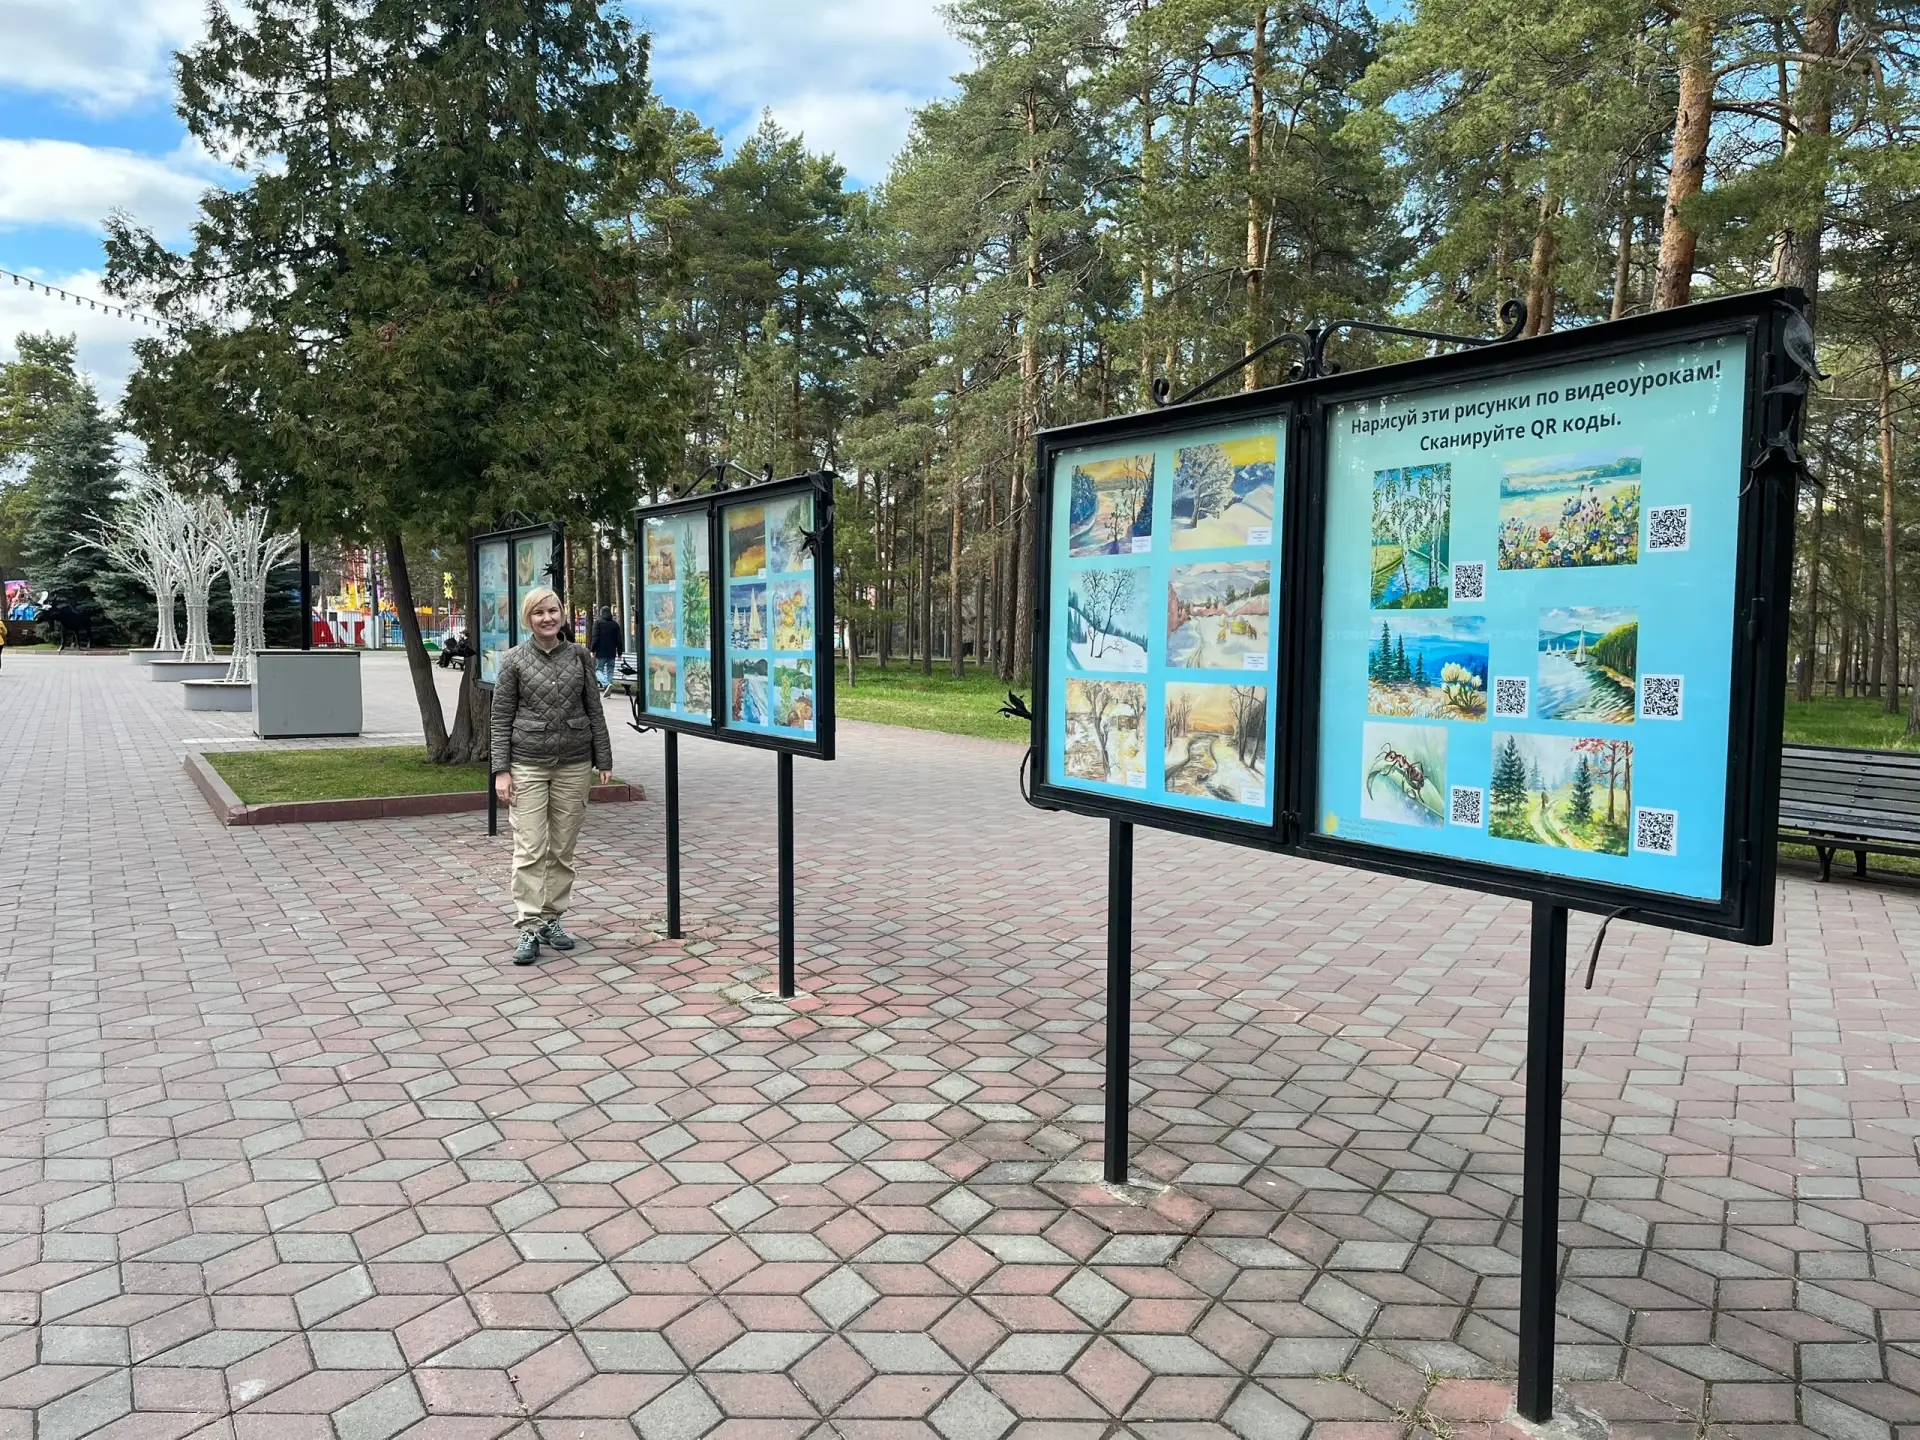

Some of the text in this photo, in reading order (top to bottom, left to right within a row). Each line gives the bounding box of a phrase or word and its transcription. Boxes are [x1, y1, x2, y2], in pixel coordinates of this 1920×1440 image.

[1351, 360, 1721, 435] Нарисуй эти рисунки по видеоурокам!
[1420, 413, 1622, 451] Сканируйте QR коды.
